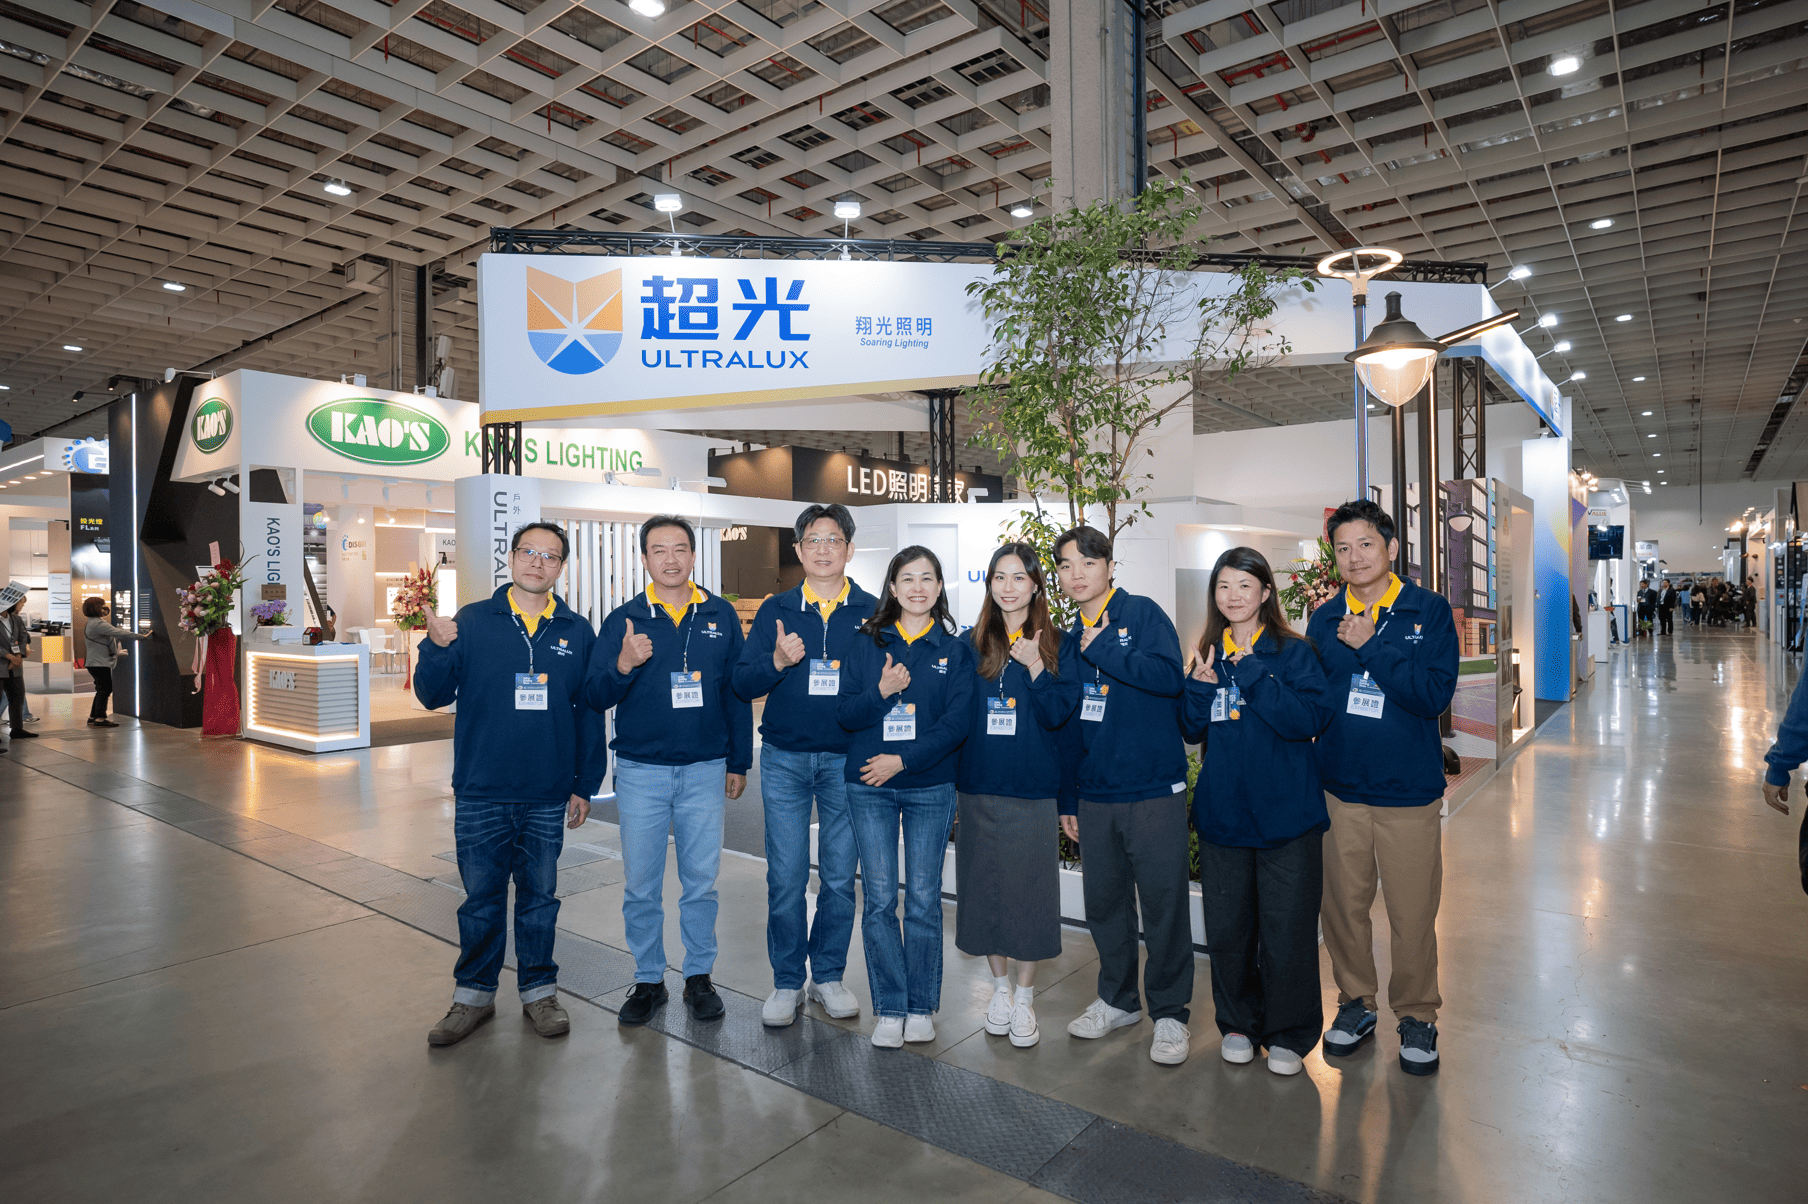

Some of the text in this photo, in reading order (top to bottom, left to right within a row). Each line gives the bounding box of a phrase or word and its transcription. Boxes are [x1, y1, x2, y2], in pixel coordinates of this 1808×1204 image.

[641, 275, 811, 341] 超光
[856, 315, 932, 337] 翔光照明
[860, 337, 929, 349] Soaring Lighting
[641, 349, 809, 369] ULTRALUX
[197, 409, 227, 441] KAO'S
[331, 411, 430, 452] KAO'S
[546, 440, 643, 472] LIGHTING
[267, 517, 281, 557] KAO'S
[720, 526, 748, 541] KAO'S
[269, 669, 296, 690] KAO'S
